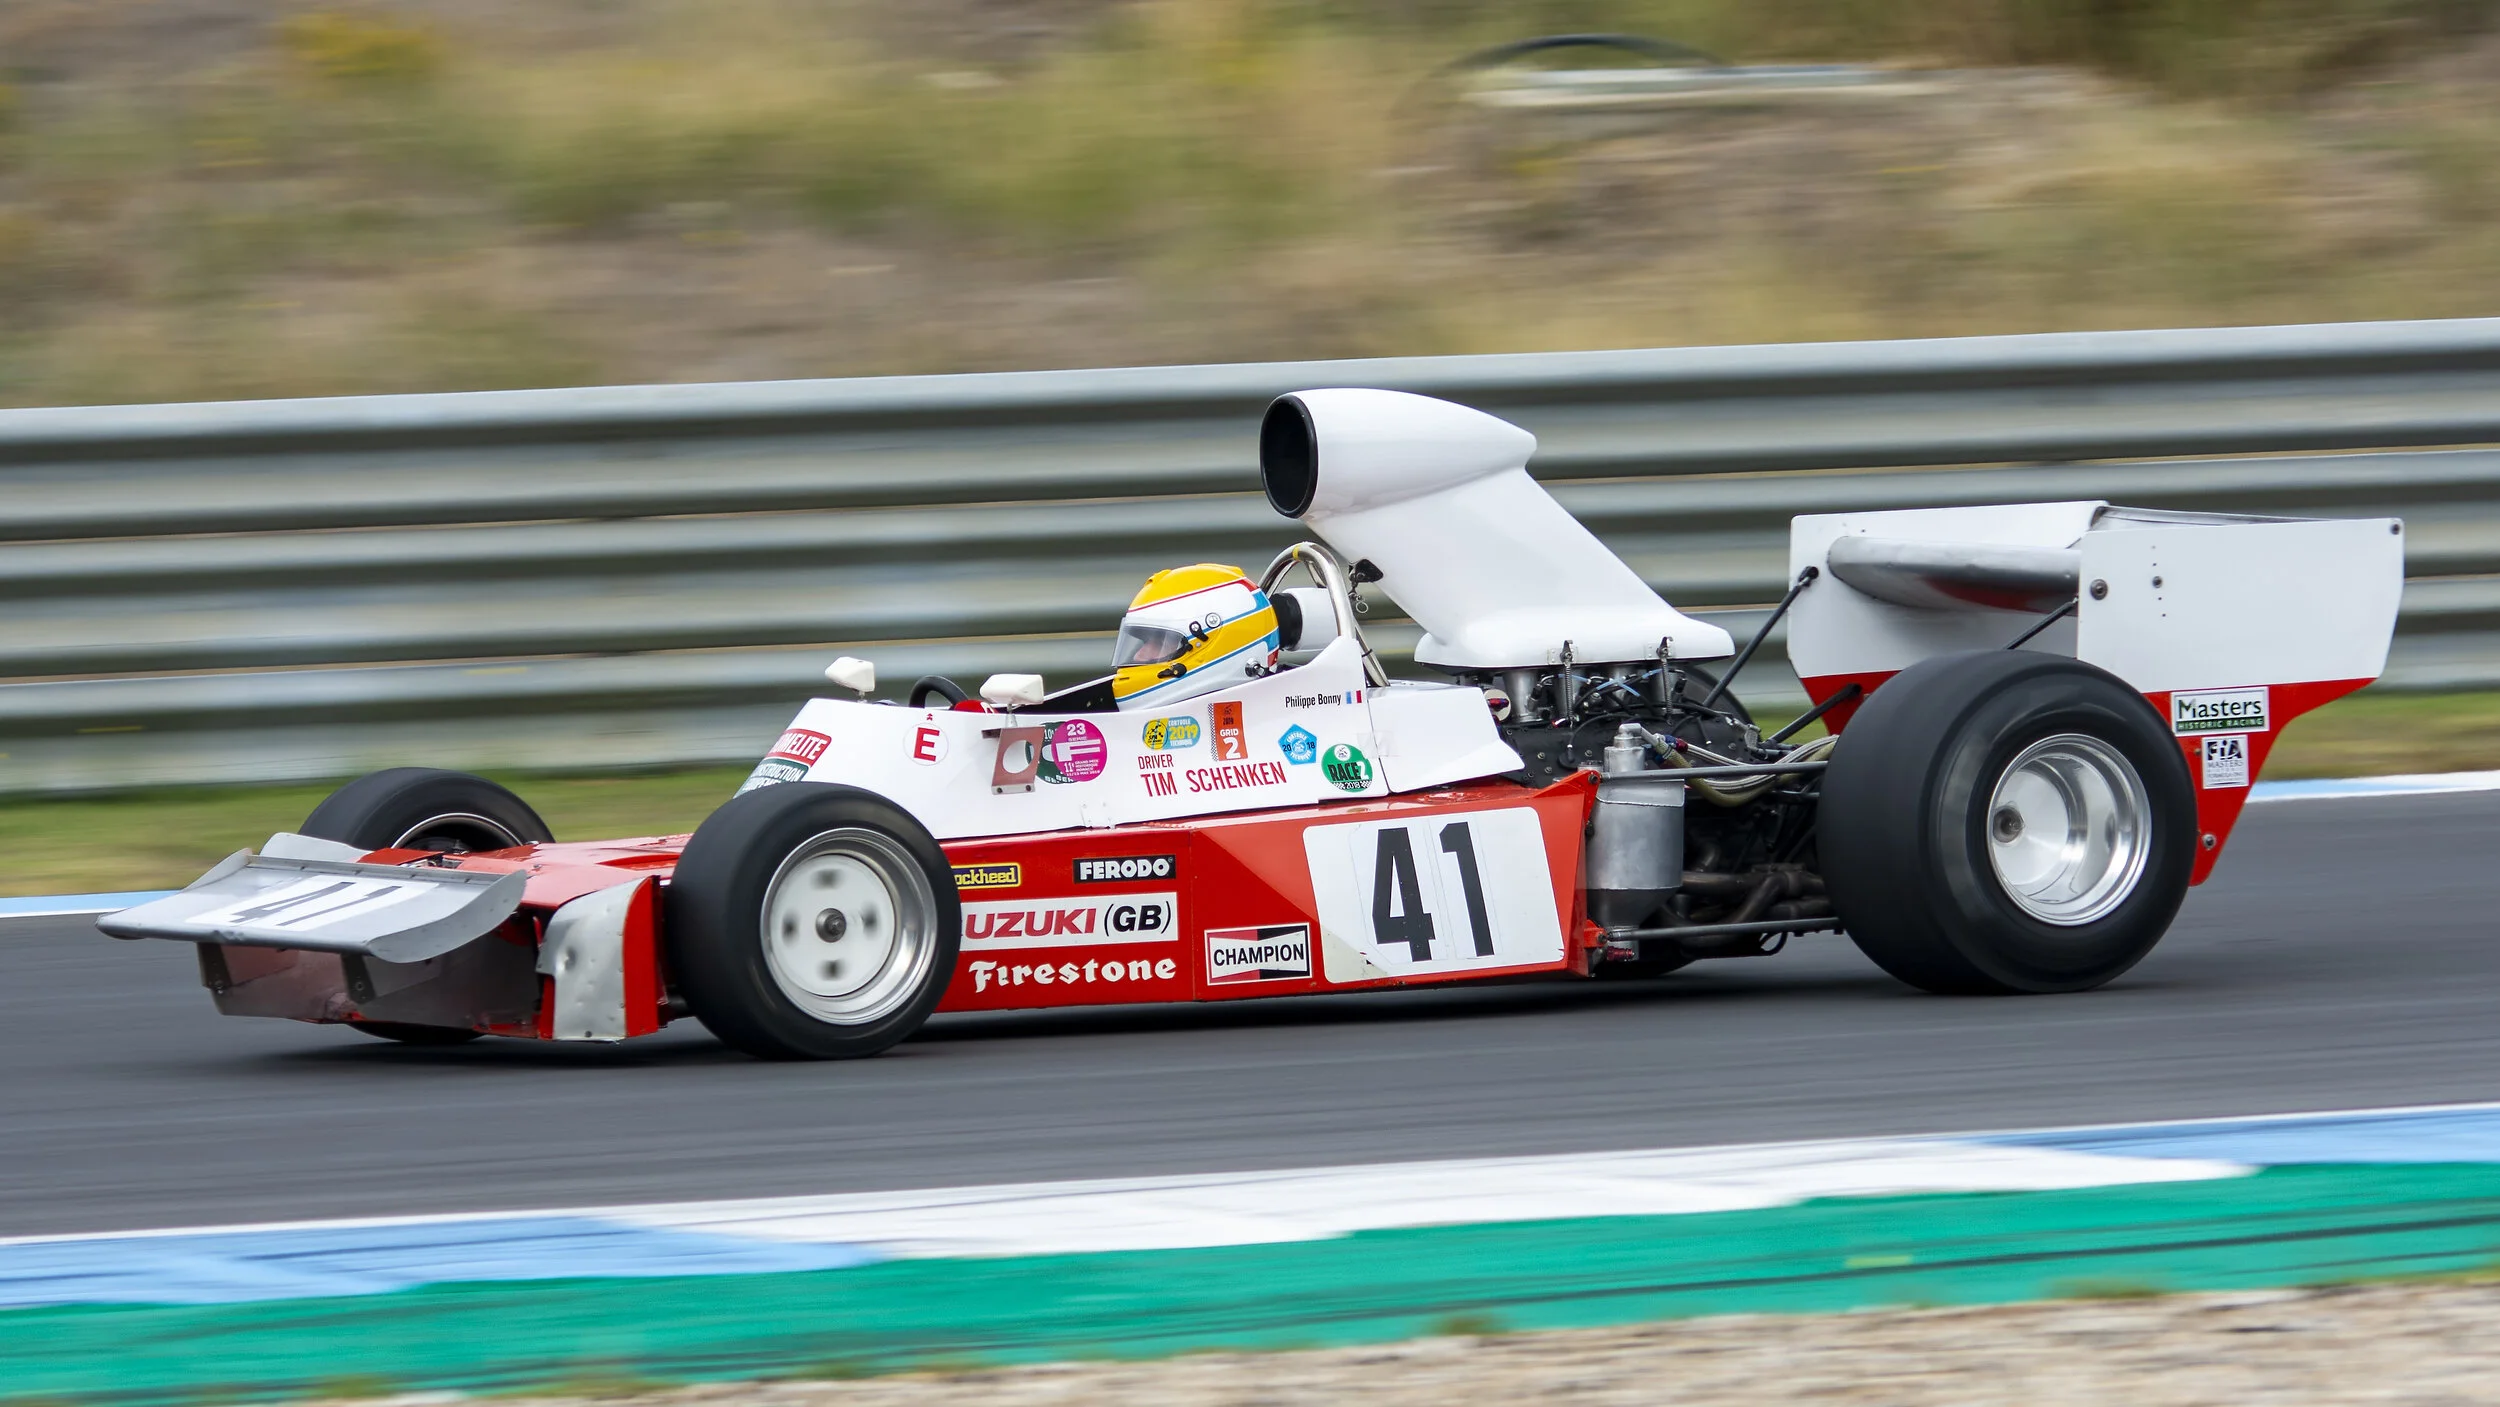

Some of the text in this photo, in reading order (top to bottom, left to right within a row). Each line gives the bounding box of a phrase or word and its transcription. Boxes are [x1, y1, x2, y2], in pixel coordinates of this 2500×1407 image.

[1285, 693, 1342, 709] Philippe Bonny
[2178, 699, 2262, 719] Masters
[1066, 722, 1086, 737] 23
[1169, 724, 1199, 741] 2019
[1219, 728, 1239, 737] GRID
[2177, 718, 2264, 730] HISTORIC RACING
[913, 727, 940, 762] E
[1223, 736, 1241, 760] 2
[1282, 744, 1292, 752] 20
[1307, 741, 1316, 749] 18
[1138, 754, 1174, 770] DRIVER
[1327, 762, 1361, 781] RACE
[1356, 761, 1369, 780] 2
[1140, 761, 1287, 797] TIM SCHENKEN
[953, 868, 1017, 886] ockheed
[1079, 858, 1170, 881] FERODO
[1372, 822, 1495, 962] 41
[229, 881, 403, 927] 41
[961, 900, 1172, 940] UZUKI (GB)
[1213, 943, 1305, 967] CHAMPION
[968, 958, 1177, 993] Firestone
